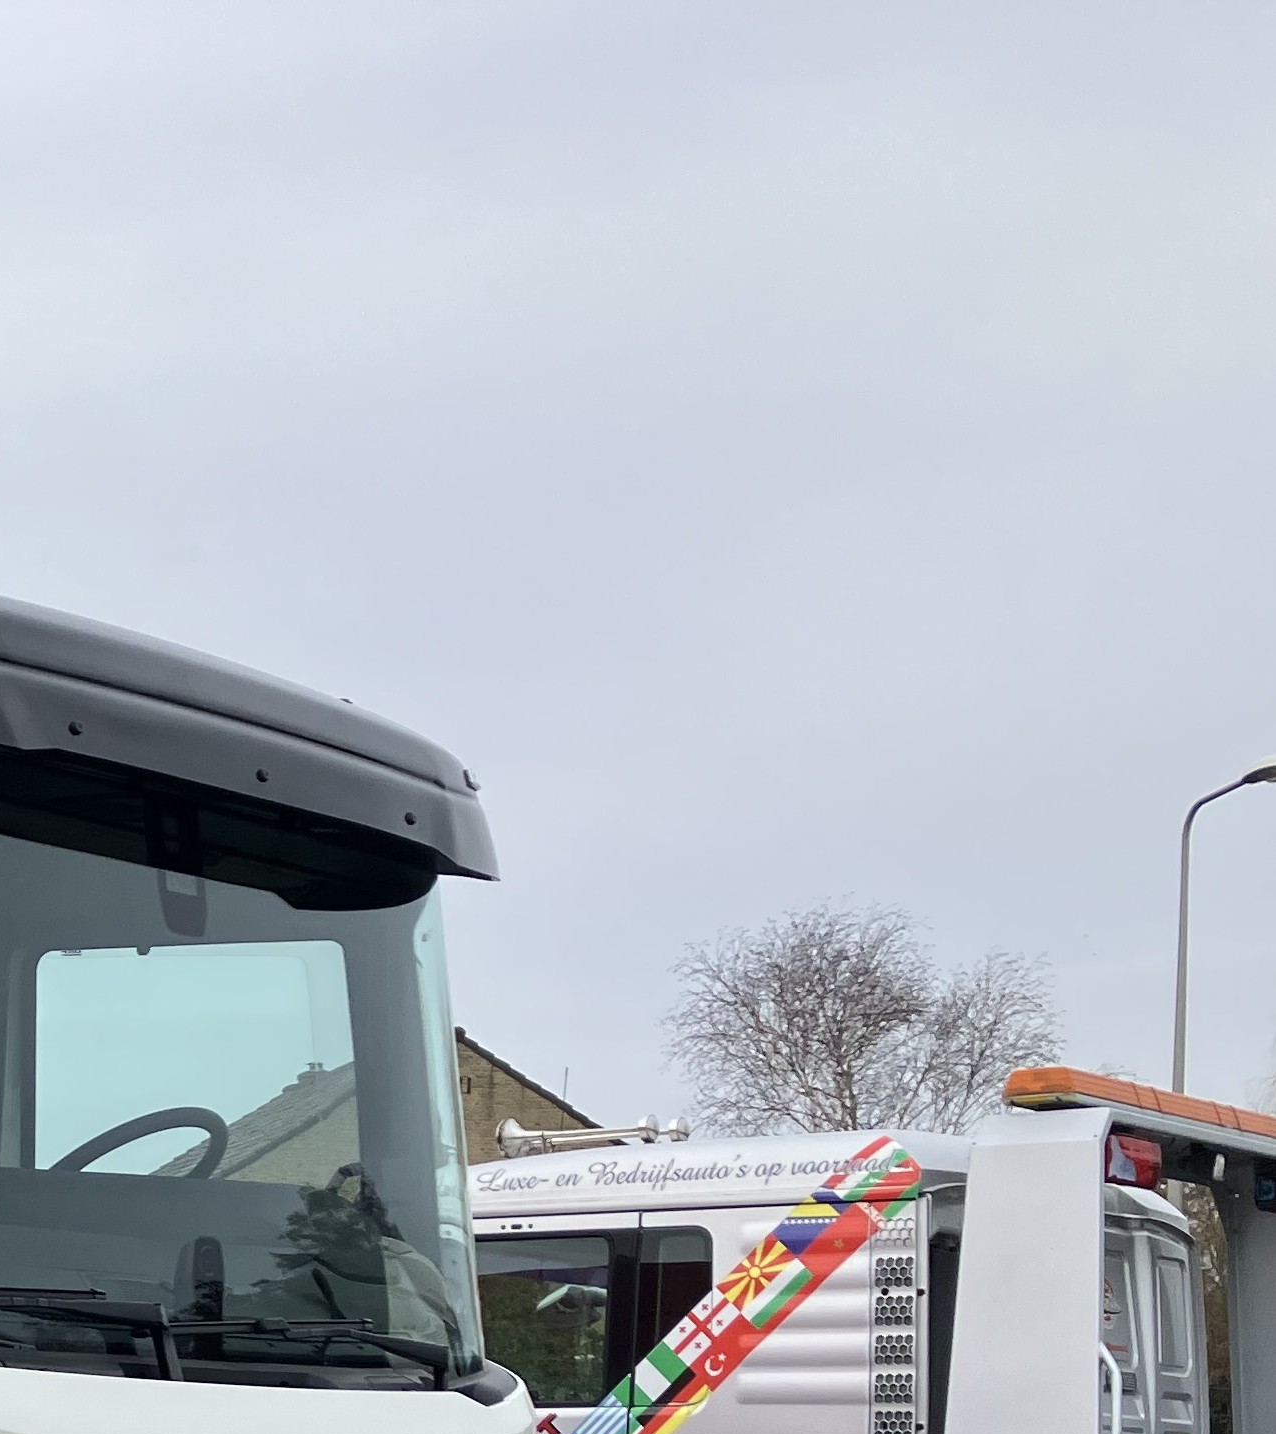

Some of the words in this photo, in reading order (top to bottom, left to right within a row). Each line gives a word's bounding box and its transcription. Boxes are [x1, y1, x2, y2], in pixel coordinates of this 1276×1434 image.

[477, 1168, 549, 1192] Luxe-
[555, 1173, 583, 1187] en
[588, 1154, 749, 1192] Bedrijfsauto's
[754, 1161, 788, 1186] op
[791, 1149, 897, 1176] voorraad
